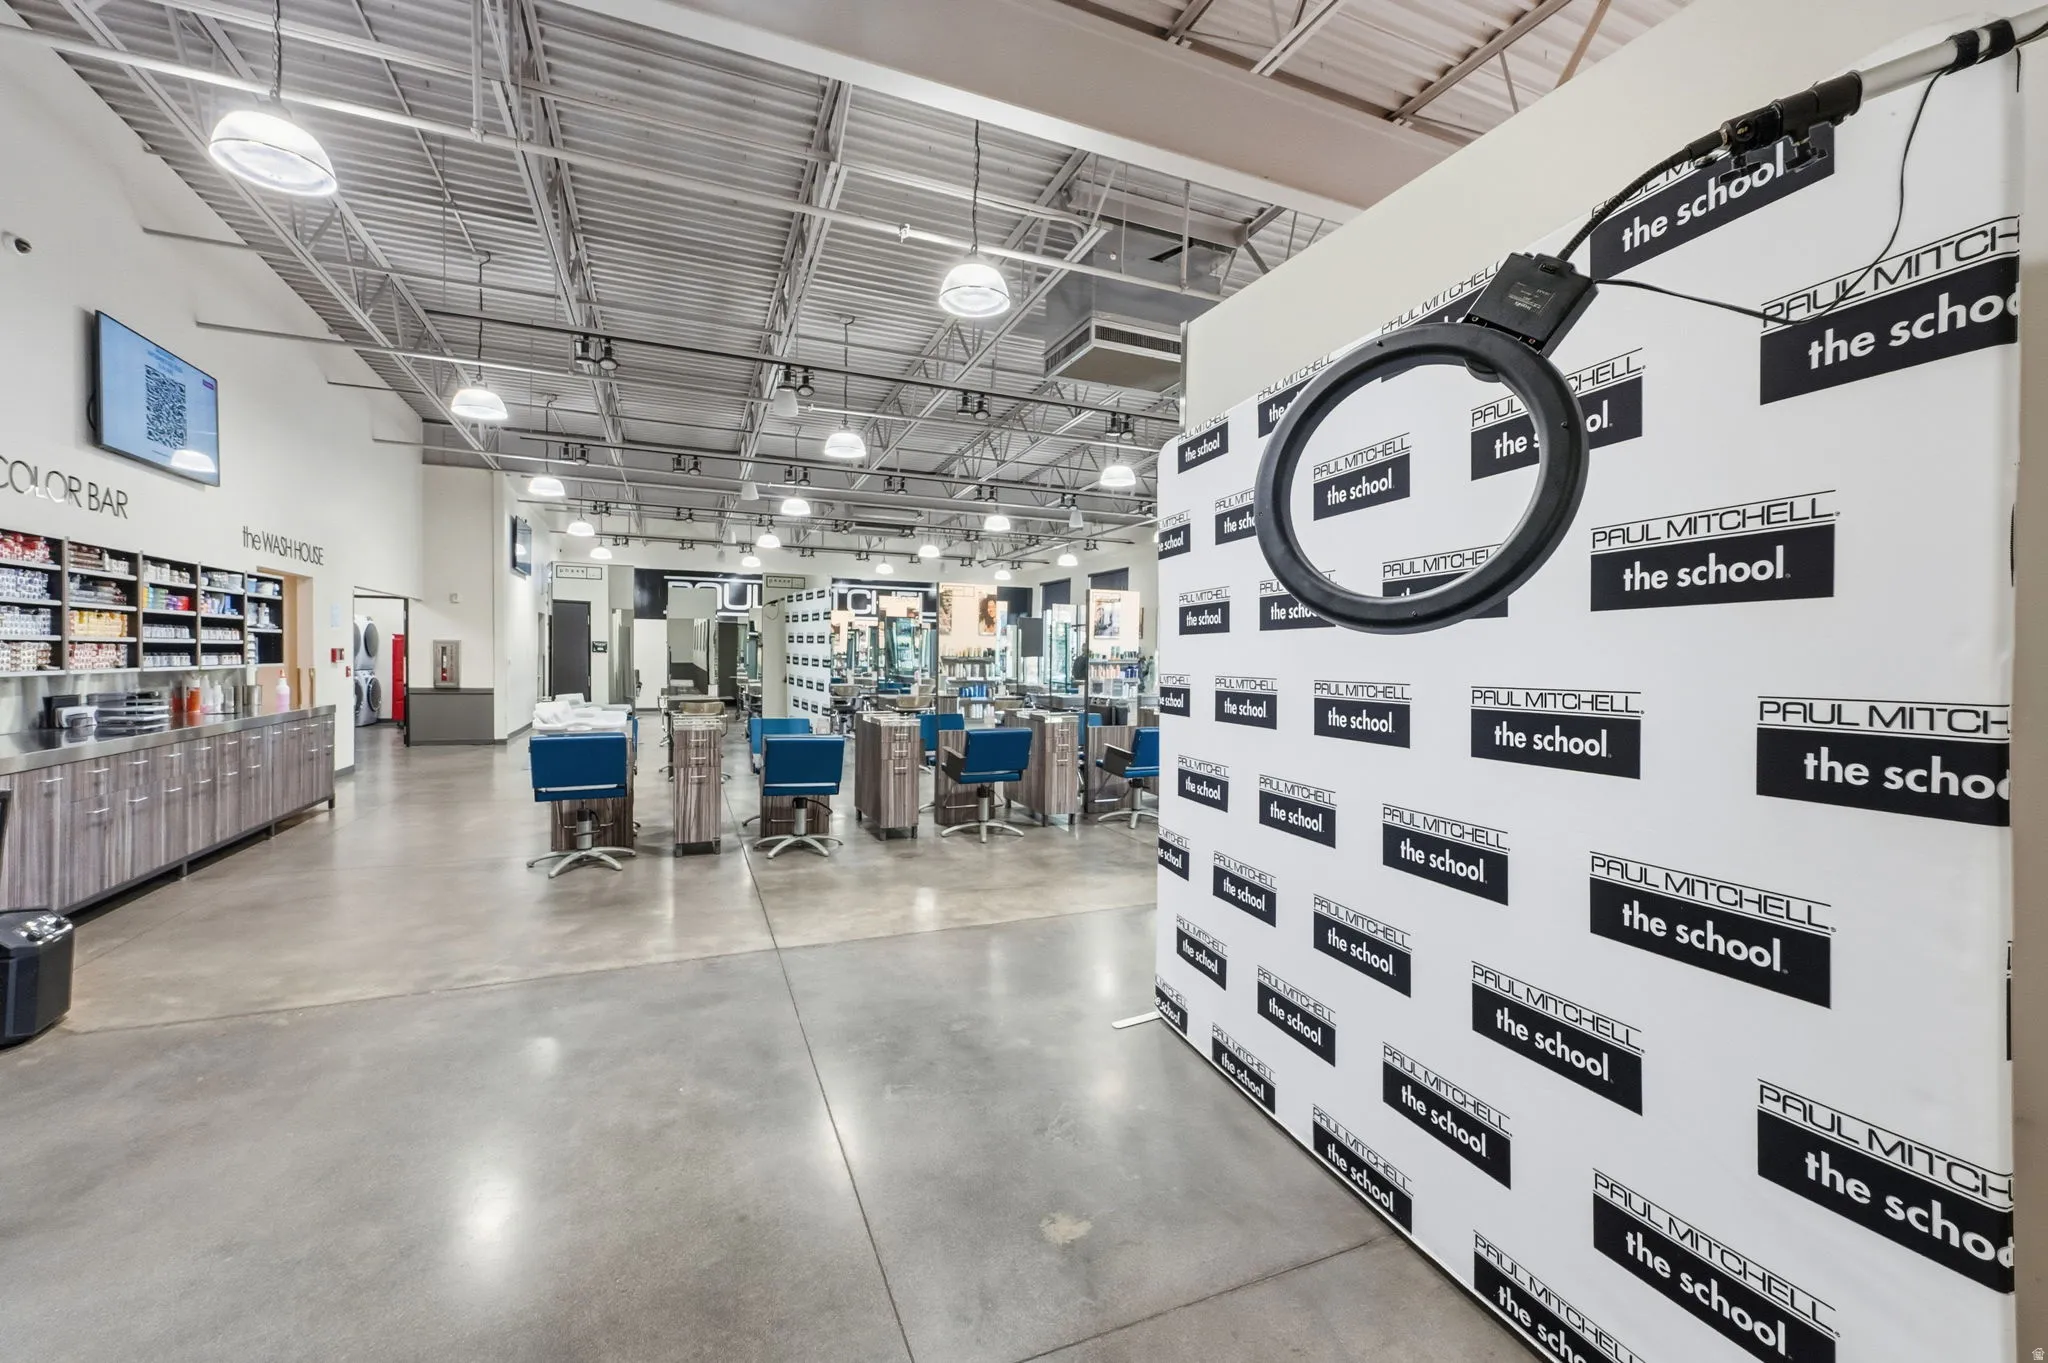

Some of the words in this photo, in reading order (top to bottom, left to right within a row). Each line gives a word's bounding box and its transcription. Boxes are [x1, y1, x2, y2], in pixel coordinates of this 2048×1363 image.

[1621, 216, 1668, 252] the
[1763, 279, 1865, 328] PAUL
[1874, 226, 2019, 291] MITCH
[1808, 328, 1875, 370] the
[1472, 399, 1521, 427] PAUL
[1567, 357, 1641, 393] CHELL
[1314, 457, 1344, 479] PAUL
[1346, 437, 1410, 469] MITCHELL
[1495, 432, 1527, 459] the
[88, 481, 128, 519] BAR
[1327, 485, 1346, 505] the
[1350, 468, 1392, 499] school
[1224, 517, 1237, 534] the
[1592, 520, 1663, 548] PAUL
[1668, 496, 1835, 538] MITCHELL
[243, 525, 261, 551] the
[262, 530, 292, 558] WASH
[293, 540, 324, 566] HOUSE
[1383, 561, 1420, 578] PAUL
[1423, 549, 1489, 572] MITCHE
[1623, 561, 1669, 591] the
[1677, 544, 1784, 586] school
[1260, 581, 1283, 594] PAUL
[1271, 602, 1286, 620] the
[1288, 602, 1317, 619] scho
[1224, 698, 1237, 714] the
[1239, 699, 1266, 717] school
[1315, 682, 1344, 696] PAUL
[1346, 684, 1410, 700] MITCHELL
[1472, 689, 1522, 707] PAUL
[1525, 691, 1641, 714] MITCHELL
[1328, 707, 1346, 727] the
[1350, 710, 1391, 733] school
[1494, 722, 1526, 748] the
[1532, 726, 1606, 757] school
[1760, 701, 1860, 726] PAUL
[1869, 705, 2010, 734] MITCH
[1804, 747, 1869, 785] the
[1260, 776, 1284, 793] PAUL
[1285, 782, 1336, 806] MITCHELL
[1270, 801, 1286, 821] the
[1288, 808, 1321, 832] school
[1383, 805, 1422, 828] PAUL
[1424, 814, 1509, 850] MITCHELL
[1400, 838, 1425, 865] the
[1429, 849, 1484, 883] school
[1222, 877, 1235, 896] the
[1237, 886, 1264, 911] school
[1591, 854, 1660, 888] PAUL
[1665, 870, 1830, 929] MITCHELL
[1314, 896, 1344, 921] PAUL
[1346, 909, 1411, 950] MITCHELL
[1621, 900, 1665, 938] the
[1674, 919, 1779, 972] school
[1327, 928, 1347, 953] the
[1350, 941, 1392, 975] school
[1258, 968, 1282, 993] PAUL
[1284, 983, 1336, 1026] MITCHELL
[1473, 963, 1523, 1000] PAUL
[1527, 985, 1642, 1051] MITCHELL
[1269, 998, 1284, 1021] the
[1287, 1013, 1321, 1045] school
[1495, 1007, 1527, 1042] the
[1533, 1030, 1607, 1081] school
[1221, 1053, 1235, 1074] the
[1237, 1069, 1264, 1100] school
[1383, 1043, 1421, 1080] PAUL
[1424, 1068, 1511, 1135] MITCHELL
[1400, 1085, 1425, 1117] the
[1429, 1107, 1485, 1158] school
[1760, 1084, 1859, 1145] PAUL
[1868, 1128, 2014, 1201] MITCH
[1314, 1105, 1343, 1140] PAUL
[1345, 1129, 1412, 1194] MITCHELL
[1327, 1143, 1347, 1172] the
[1350, 1158, 1394, 1212] school
[1805, 1151, 1871, 1204] the
[1475, 1234, 1525, 1286] PAUL
[1595, 1172, 1663, 1230] PAUL
[1669, 1217, 1833, 1333] MITCHELL
[1498, 1285, 1532, 1327] the
[1626, 1232, 1671, 1278] the
[1680, 1278, 1785, 1356] school
